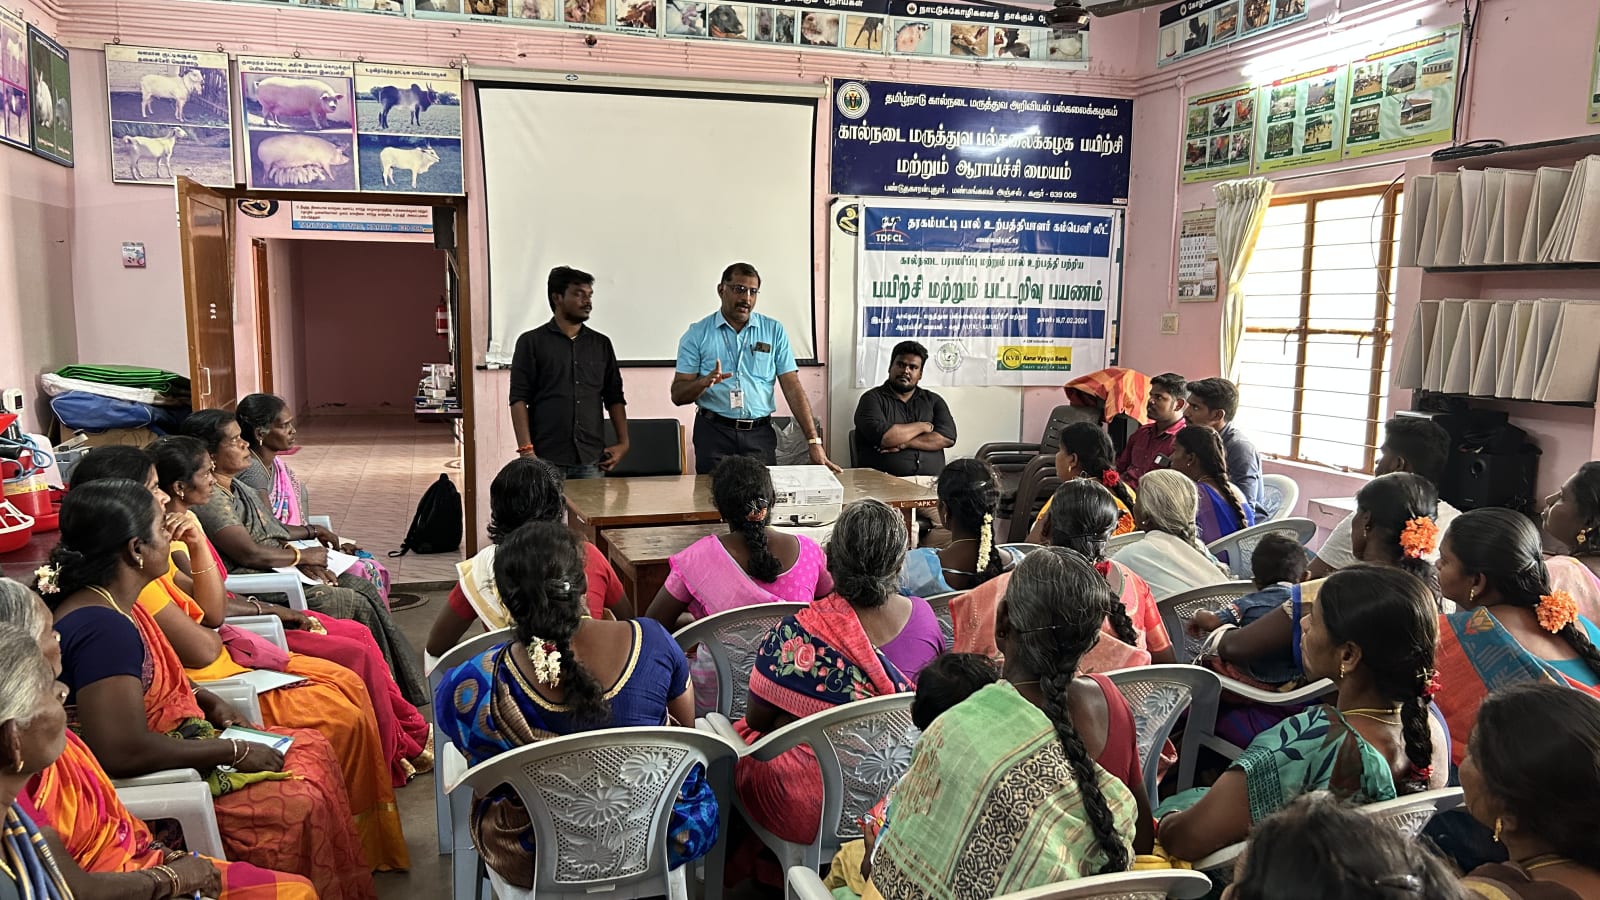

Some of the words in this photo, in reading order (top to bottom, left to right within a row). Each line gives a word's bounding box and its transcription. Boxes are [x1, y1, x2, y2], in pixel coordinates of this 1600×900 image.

[918, 5, 1000, 20] நாட்டுக்கோழிகளைத்
[1003, 10, 1034, 22] தாக்கும்
[885, 90, 926, 107] தமிழ்நாடு
[928, 92, 968, 109] கால்நடை
[970, 95, 1007, 111] மருத்துவ
[1010, 98, 1051, 114] அறிவியல்
[1053, 101, 1118, 119] பல்கலைக்கழகம்
[838, 119, 905, 145] கால்நடை
[909, 122, 974, 150] மருத்துவ
[976, 126, 1075, 155] பல்கலைக்கழக
[1080, 133, 1123, 157] பயிற்சி
[896, 152, 949, 180] மற்றும்
[955, 154, 1021, 180] ஆராய்ச்சி
[1024, 160, 1072, 181] மையம்
[1063, 191, 1077, 199] 006
[907, 215, 958, 232] தரகம்பட்டி
[960, 217, 982, 230] பால்
[984, 217, 1050, 232] உற்பத்தியாளர்
[1053, 220, 1091, 233] கம்பெனி
[1093, 222, 1109, 235] லிட்
[900, 254, 938, 267] கால்நடை
[941, 254, 978, 268] பராமரிப்பு
[979, 255, 1006, 269] மற்றும்
[1007, 256, 1024, 267] பால்
[1027, 256, 1060, 271] உற்பத்தி
[1061, 257, 1084, 272] பற்றிய
[872, 273, 924, 304] பயிற்சி
[928, 275, 979, 305] மற்றும்
[984, 275, 1044, 305] பட்டறிவு
[1049, 279, 1103, 303] பயணம்
[1037, 355, 1054, 363] Vysya
